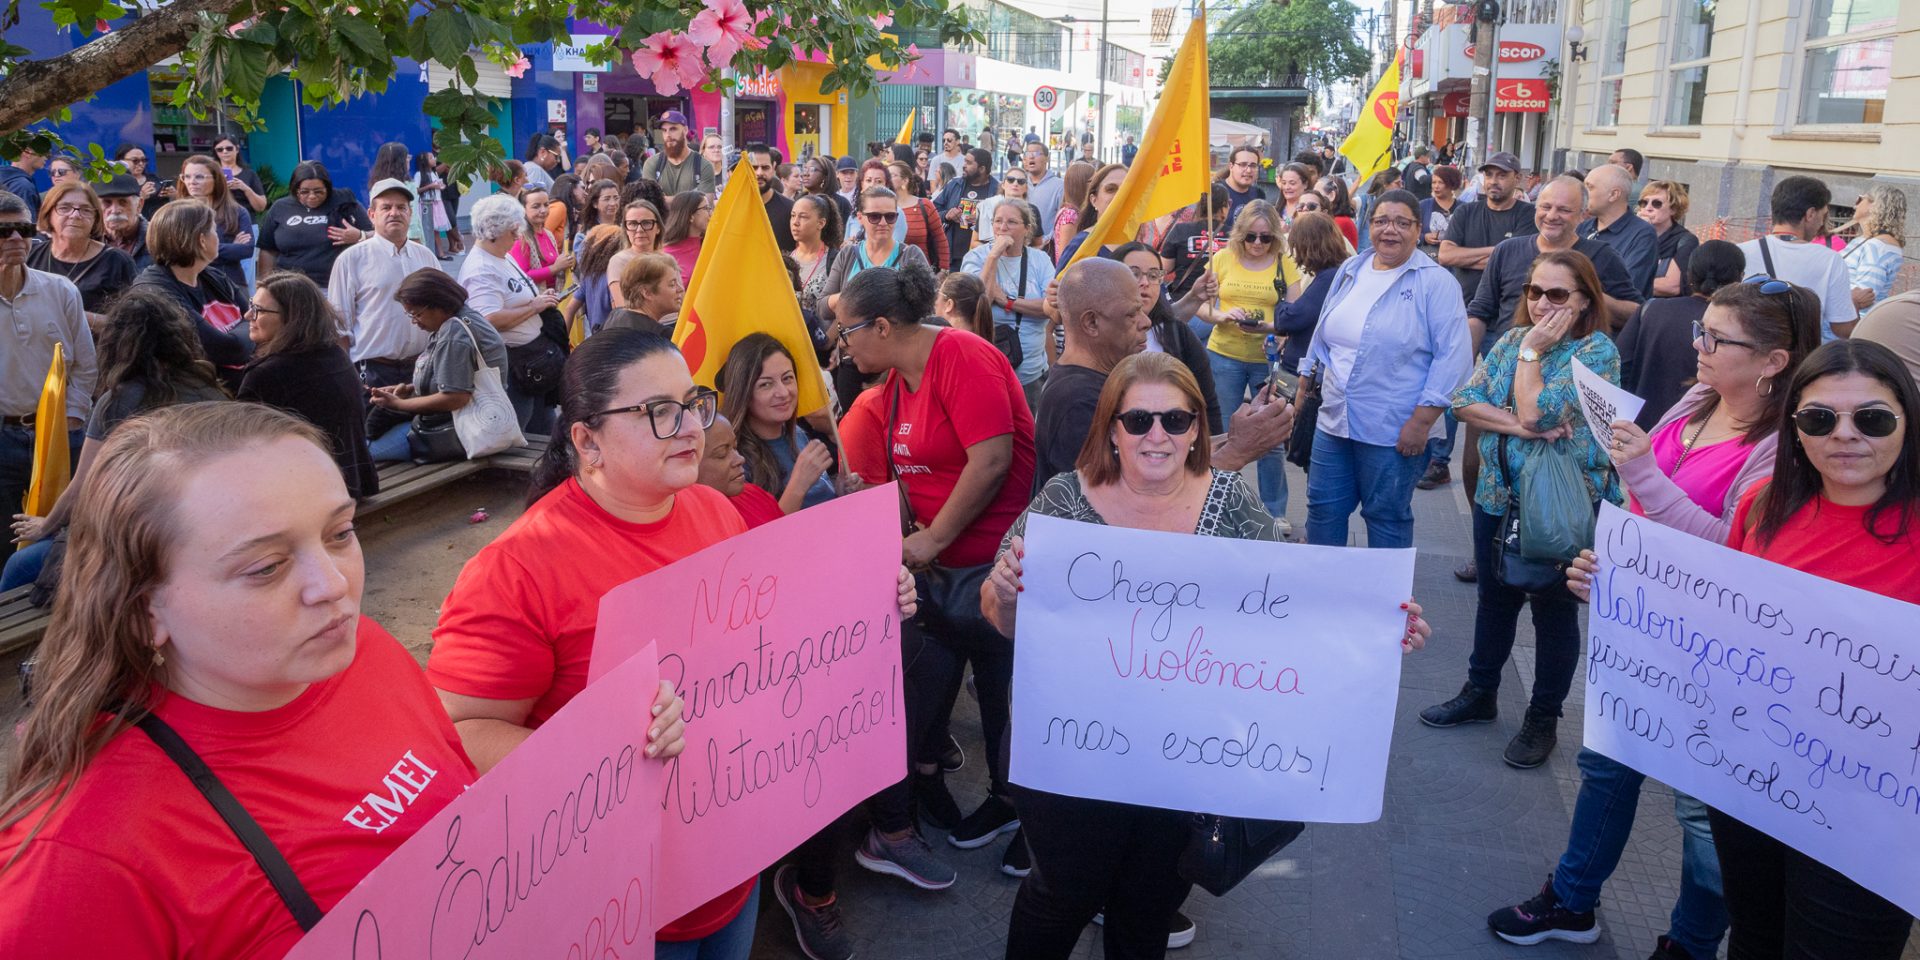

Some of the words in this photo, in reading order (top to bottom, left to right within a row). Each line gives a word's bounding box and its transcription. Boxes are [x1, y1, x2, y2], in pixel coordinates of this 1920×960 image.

[566, 48, 587, 56] KHA
[1038, 91, 1053, 104] 30
[1496, 97, 1546, 108] brascon
[1587, 388, 1607, 408] DEFESA
[1608, 403, 1617, 417] DA
[690, 551, 778, 648] Não
[1067, 551, 1205, 642] Chega
[1236, 573, 1289, 618] de
[1607, 517, 1794, 636] Queremos
[880, 614, 894, 643] e
[1107, 607, 1305, 695] Violência
[1594, 566, 1796, 694] Valorização
[1814, 671, 1892, 738] dos
[1732, 705, 1750, 732] e
[342, 749, 437, 834] EMEI
[1162, 721, 1331, 792] escolas!
